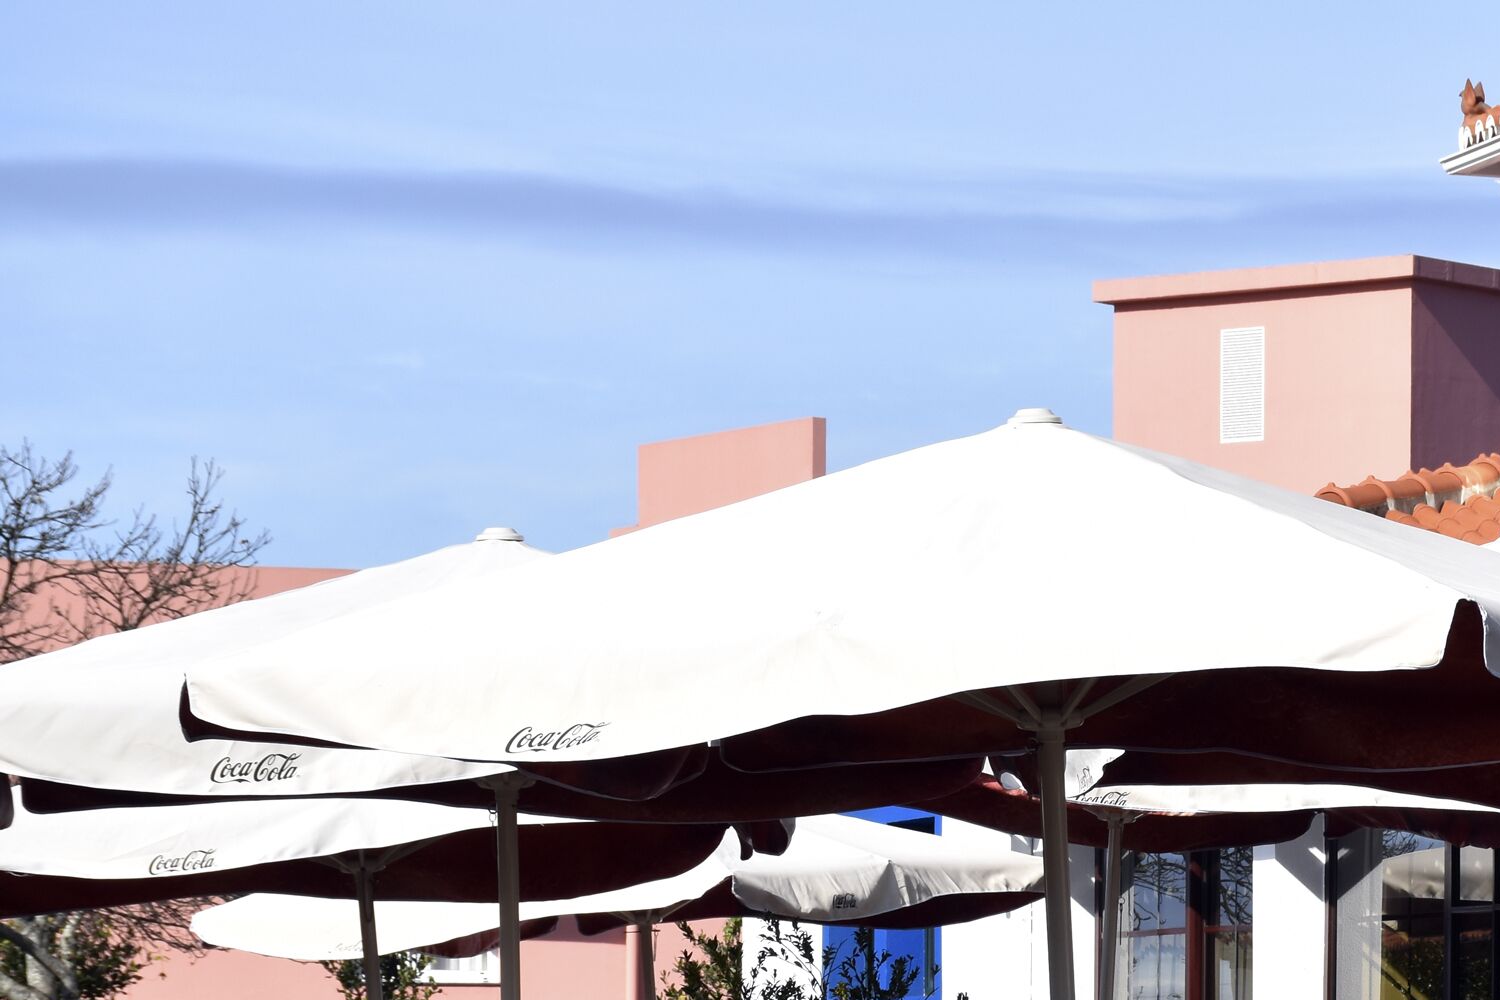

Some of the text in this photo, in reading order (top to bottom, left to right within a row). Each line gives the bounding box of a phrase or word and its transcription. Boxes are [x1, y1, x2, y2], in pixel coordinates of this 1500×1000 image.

[505, 721, 612, 754] Coca-Cola
[210, 753, 303, 784] Coca-Cola
[148, 848, 217, 876] Coca-Cola
